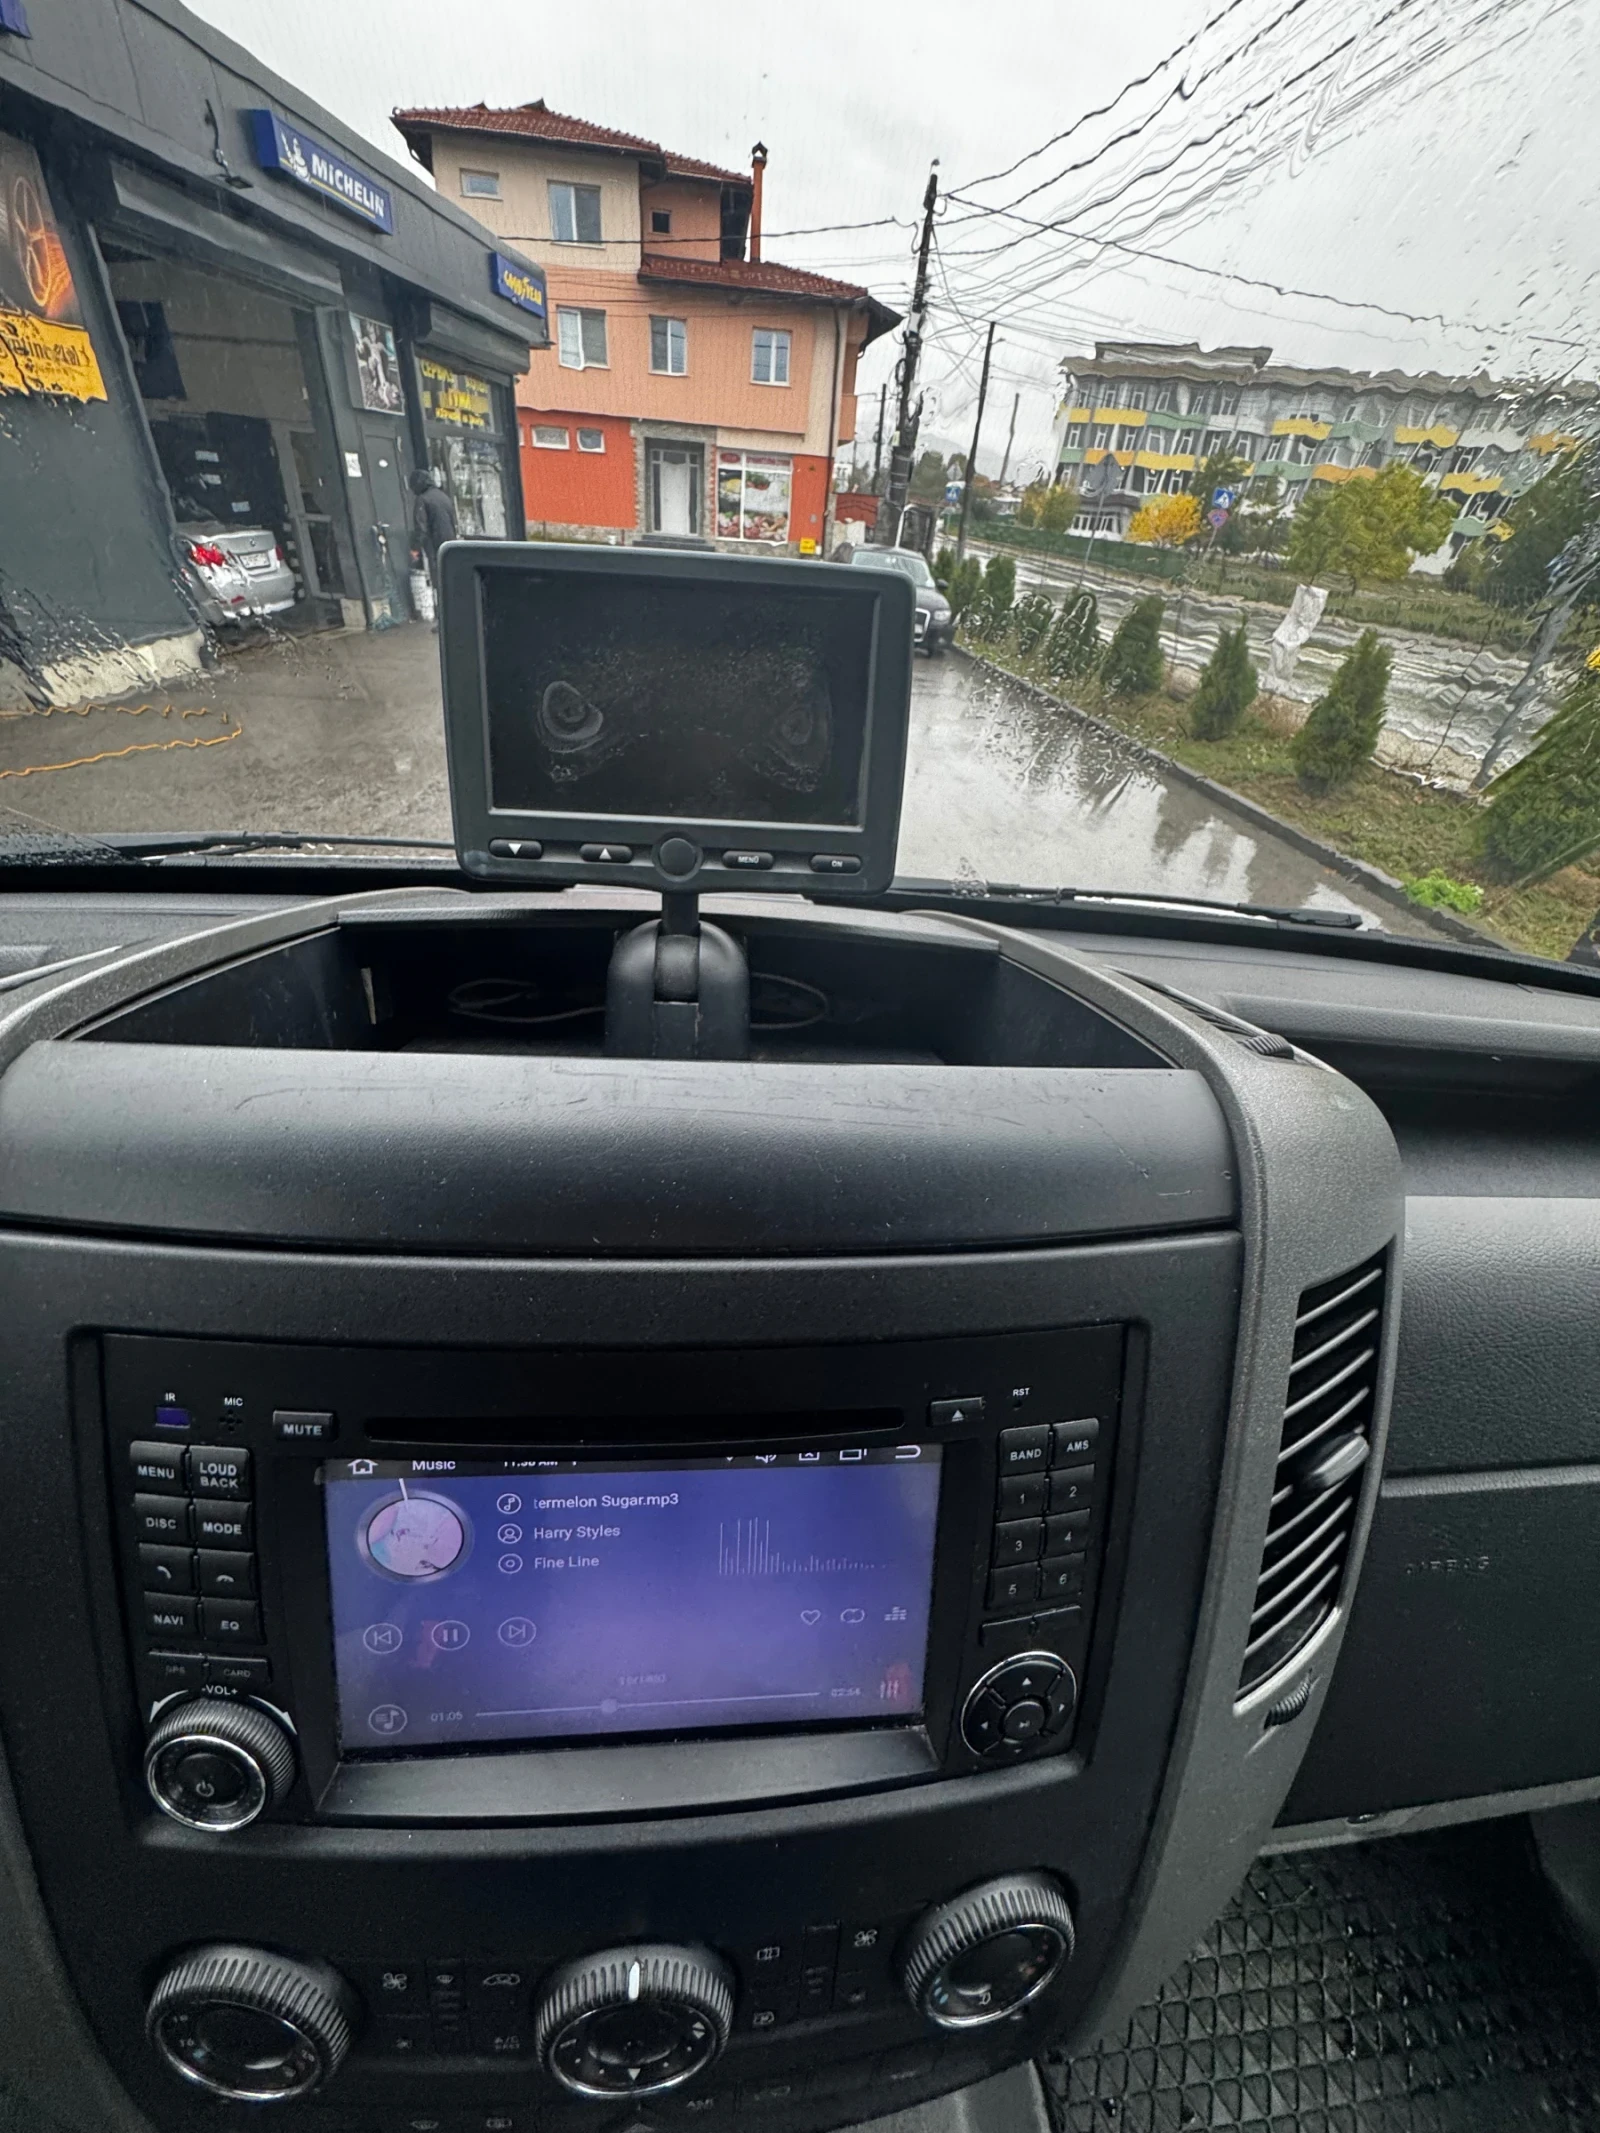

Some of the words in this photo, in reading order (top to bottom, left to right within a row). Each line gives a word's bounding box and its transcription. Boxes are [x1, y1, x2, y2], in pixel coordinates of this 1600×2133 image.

[312, 153, 384, 218] MICHELIN
[831, 860, 843, 868] ON
[165, 1392, 176, 1402] IR
[1012, 1387, 1031, 1396] RST
[224, 1397, 243, 1407] MIC
[283, 1424, 322, 1436] MUTE
[1066, 1439, 1089, 1453] AMS
[1010, 1448, 1042, 1461] BAND
[137, 1465, 175, 1480] MENU
[200, 1462, 237, 1476] LOUD
[200, 1476, 239, 1489] BACK
[1069, 1486, 1077, 1498] 2
[601, 1493, 679, 1509] Sugar.mp3
[1020, 1493, 1025, 1504] 1
[146, 1517, 177, 1529] DISC
[203, 1522, 242, 1534] MODE
[534, 1527, 573, 1542] Harry
[576, 1524, 621, 1541] Styles
[1064, 1531, 1072, 1541] 4
[1015, 1540, 1023, 1551] 3
[534, 1557, 564, 1569] Fine
[568, 1556, 600, 1568] Line
[1059, 1573, 1068, 1585] 6
[1008, 1584, 1017, 1595] 5
[153, 1614, 184, 1626] NAVI
[220, 1620, 240, 1631] EQ
[223, 1668, 251, 1680] CARD
